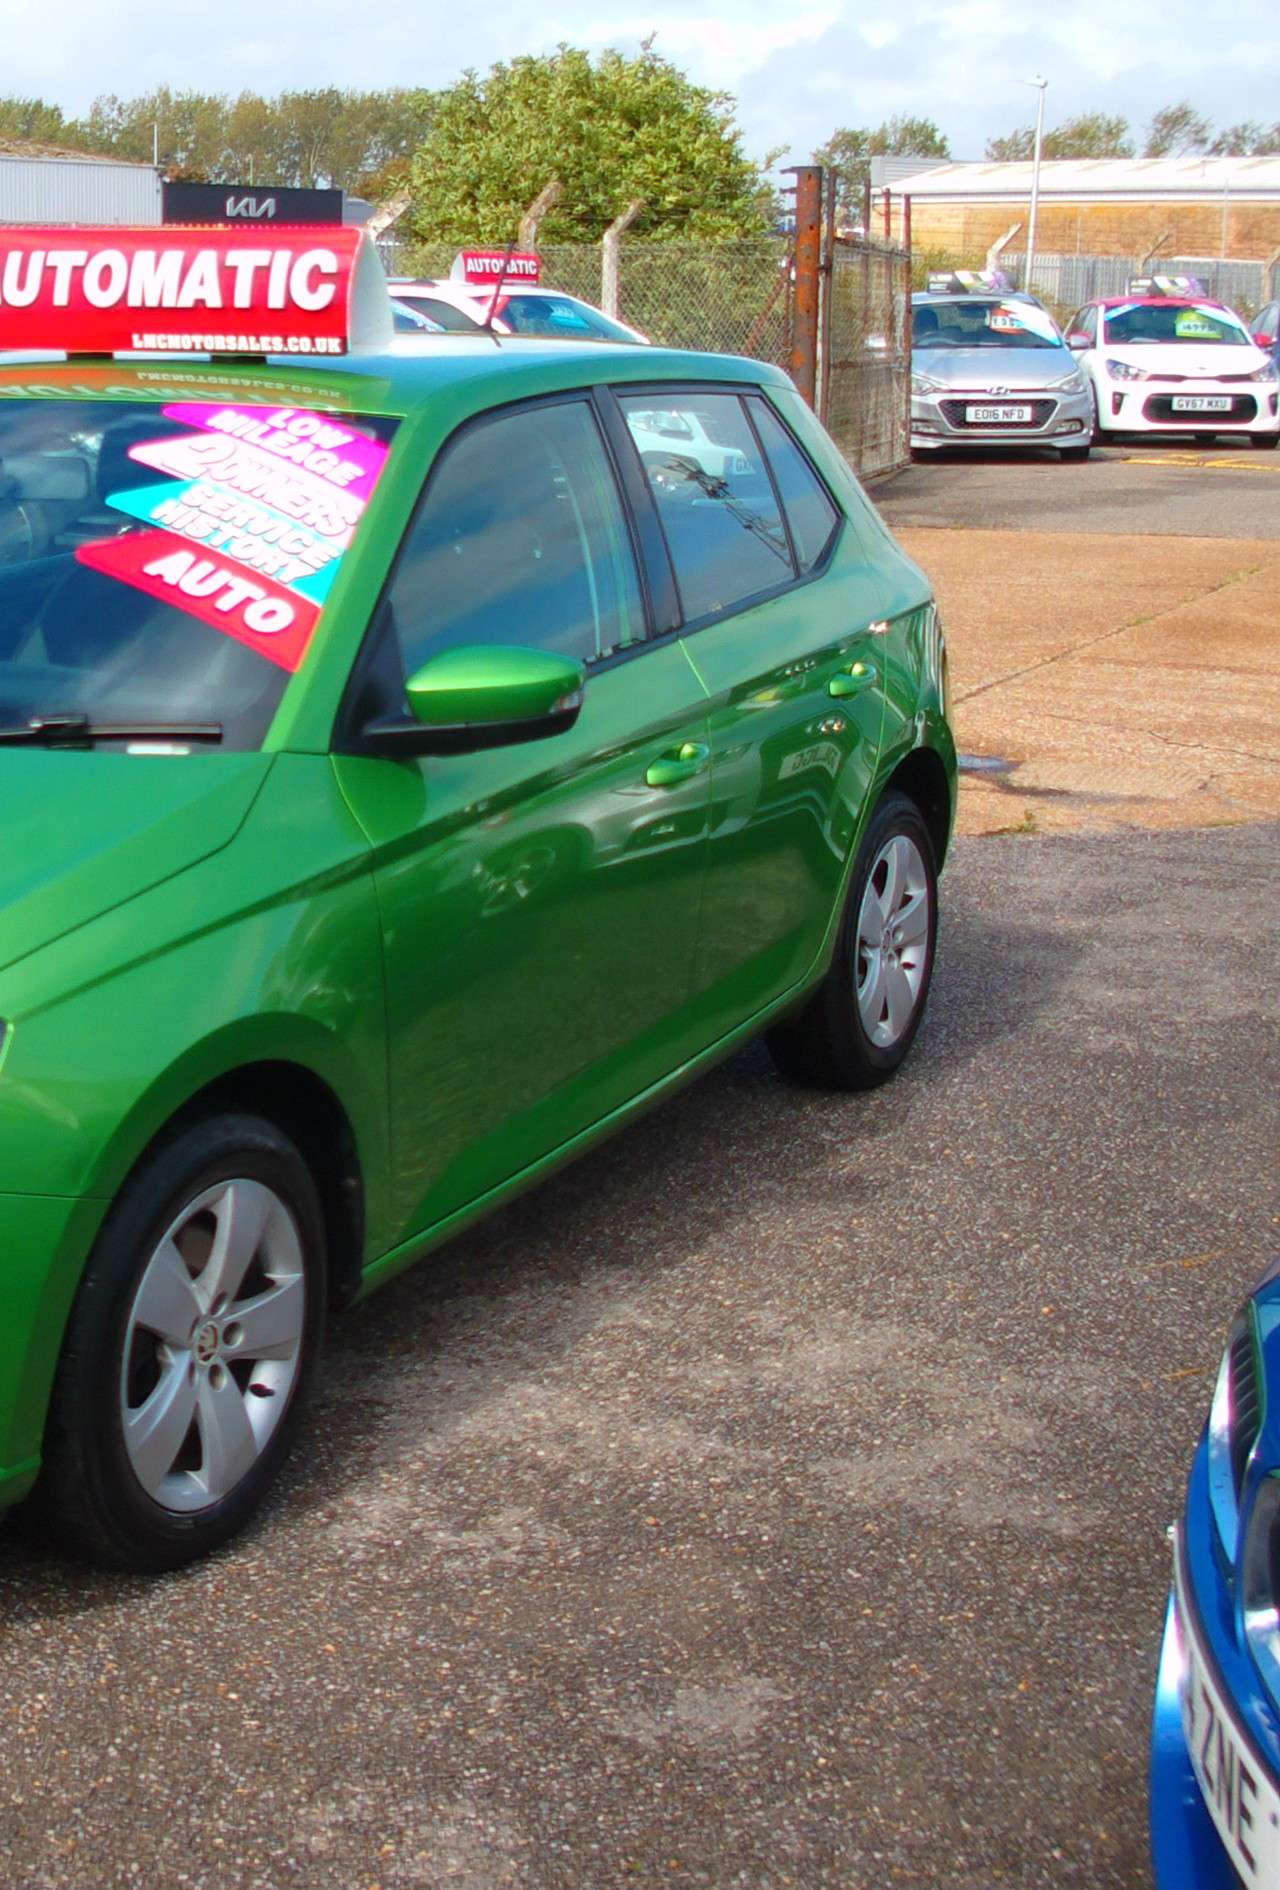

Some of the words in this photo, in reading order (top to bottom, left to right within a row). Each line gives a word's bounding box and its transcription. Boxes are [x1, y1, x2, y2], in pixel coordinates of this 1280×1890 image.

[225, 196, 277, 218] KIA
[131, 333, 343, 353] LMCMOTORSALES.CO.UK
[205, 409, 366, 488] MILEAGE
[264, 408, 356, 450] LOW
[179, 480, 343, 571] SERVICE
[210, 456, 360, 537] OWNERS
[149, 498, 317, 585] HISTORY
[142, 550, 298, 635] AUTO
